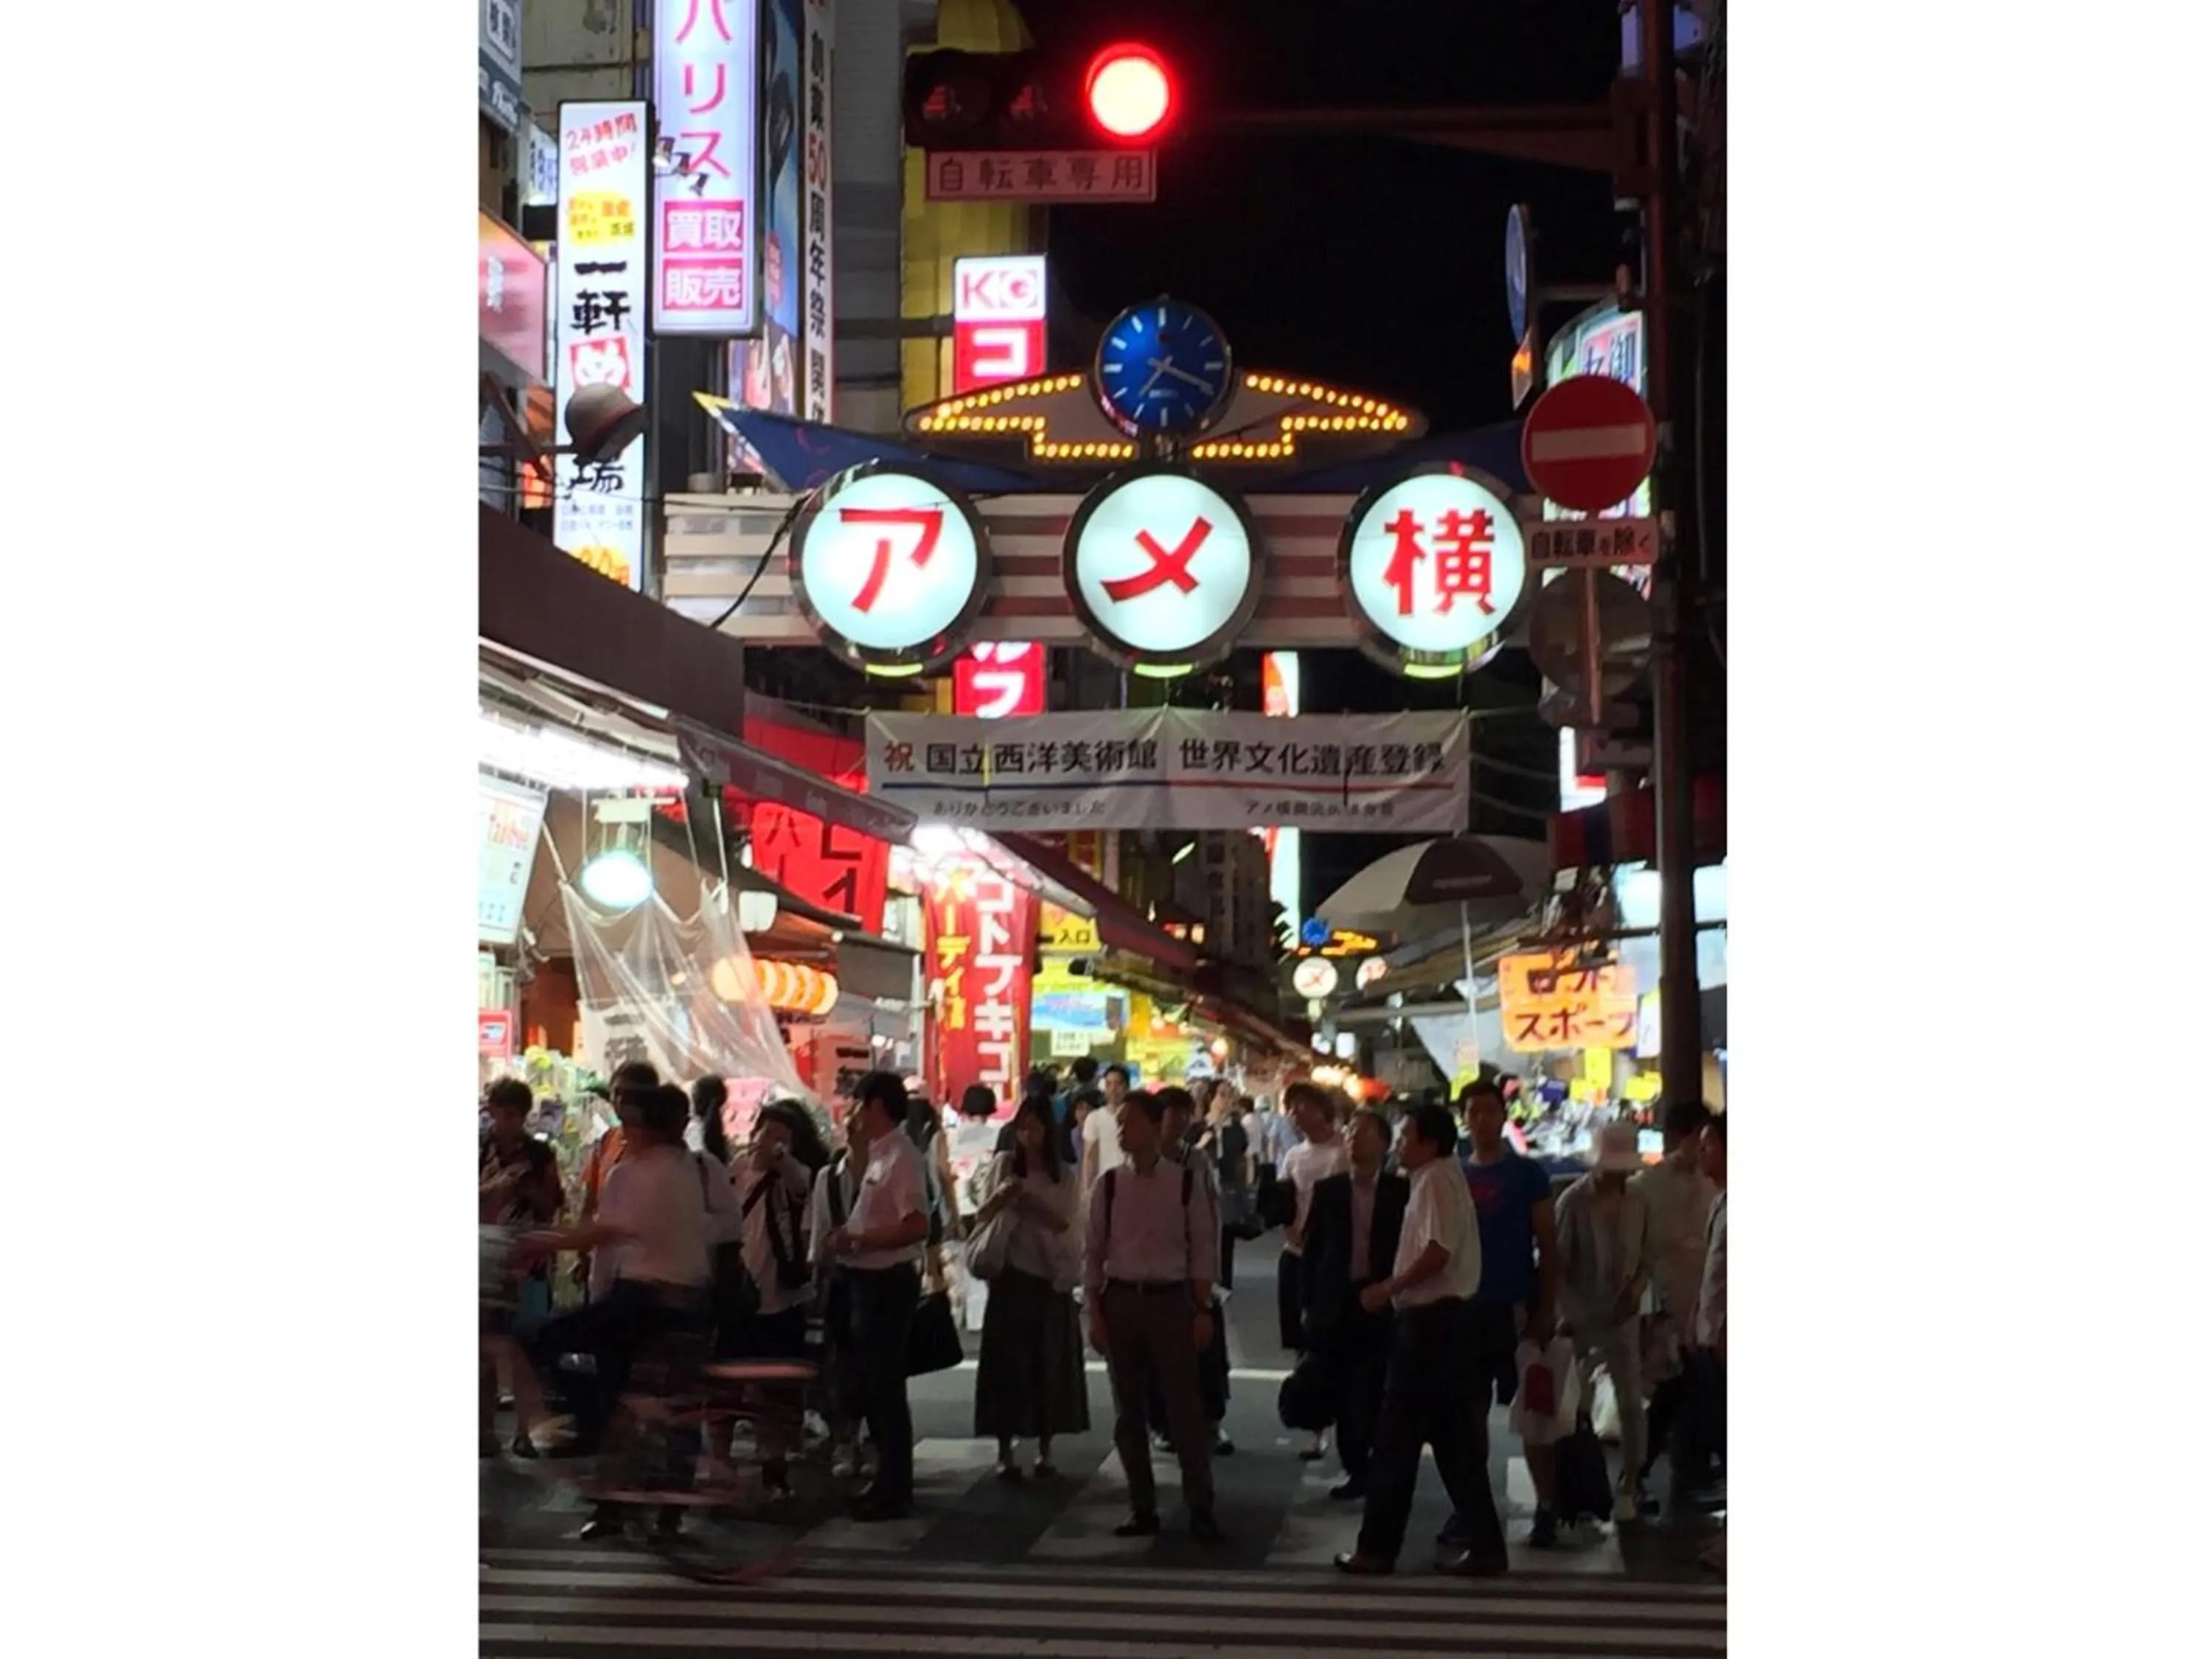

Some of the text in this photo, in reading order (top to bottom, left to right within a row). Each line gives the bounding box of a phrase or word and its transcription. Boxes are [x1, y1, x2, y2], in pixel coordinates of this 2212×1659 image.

[939, 156, 1142, 191] 自転車専用
[667, 209, 742, 249] 買取
[665, 266, 742, 307] 販売
